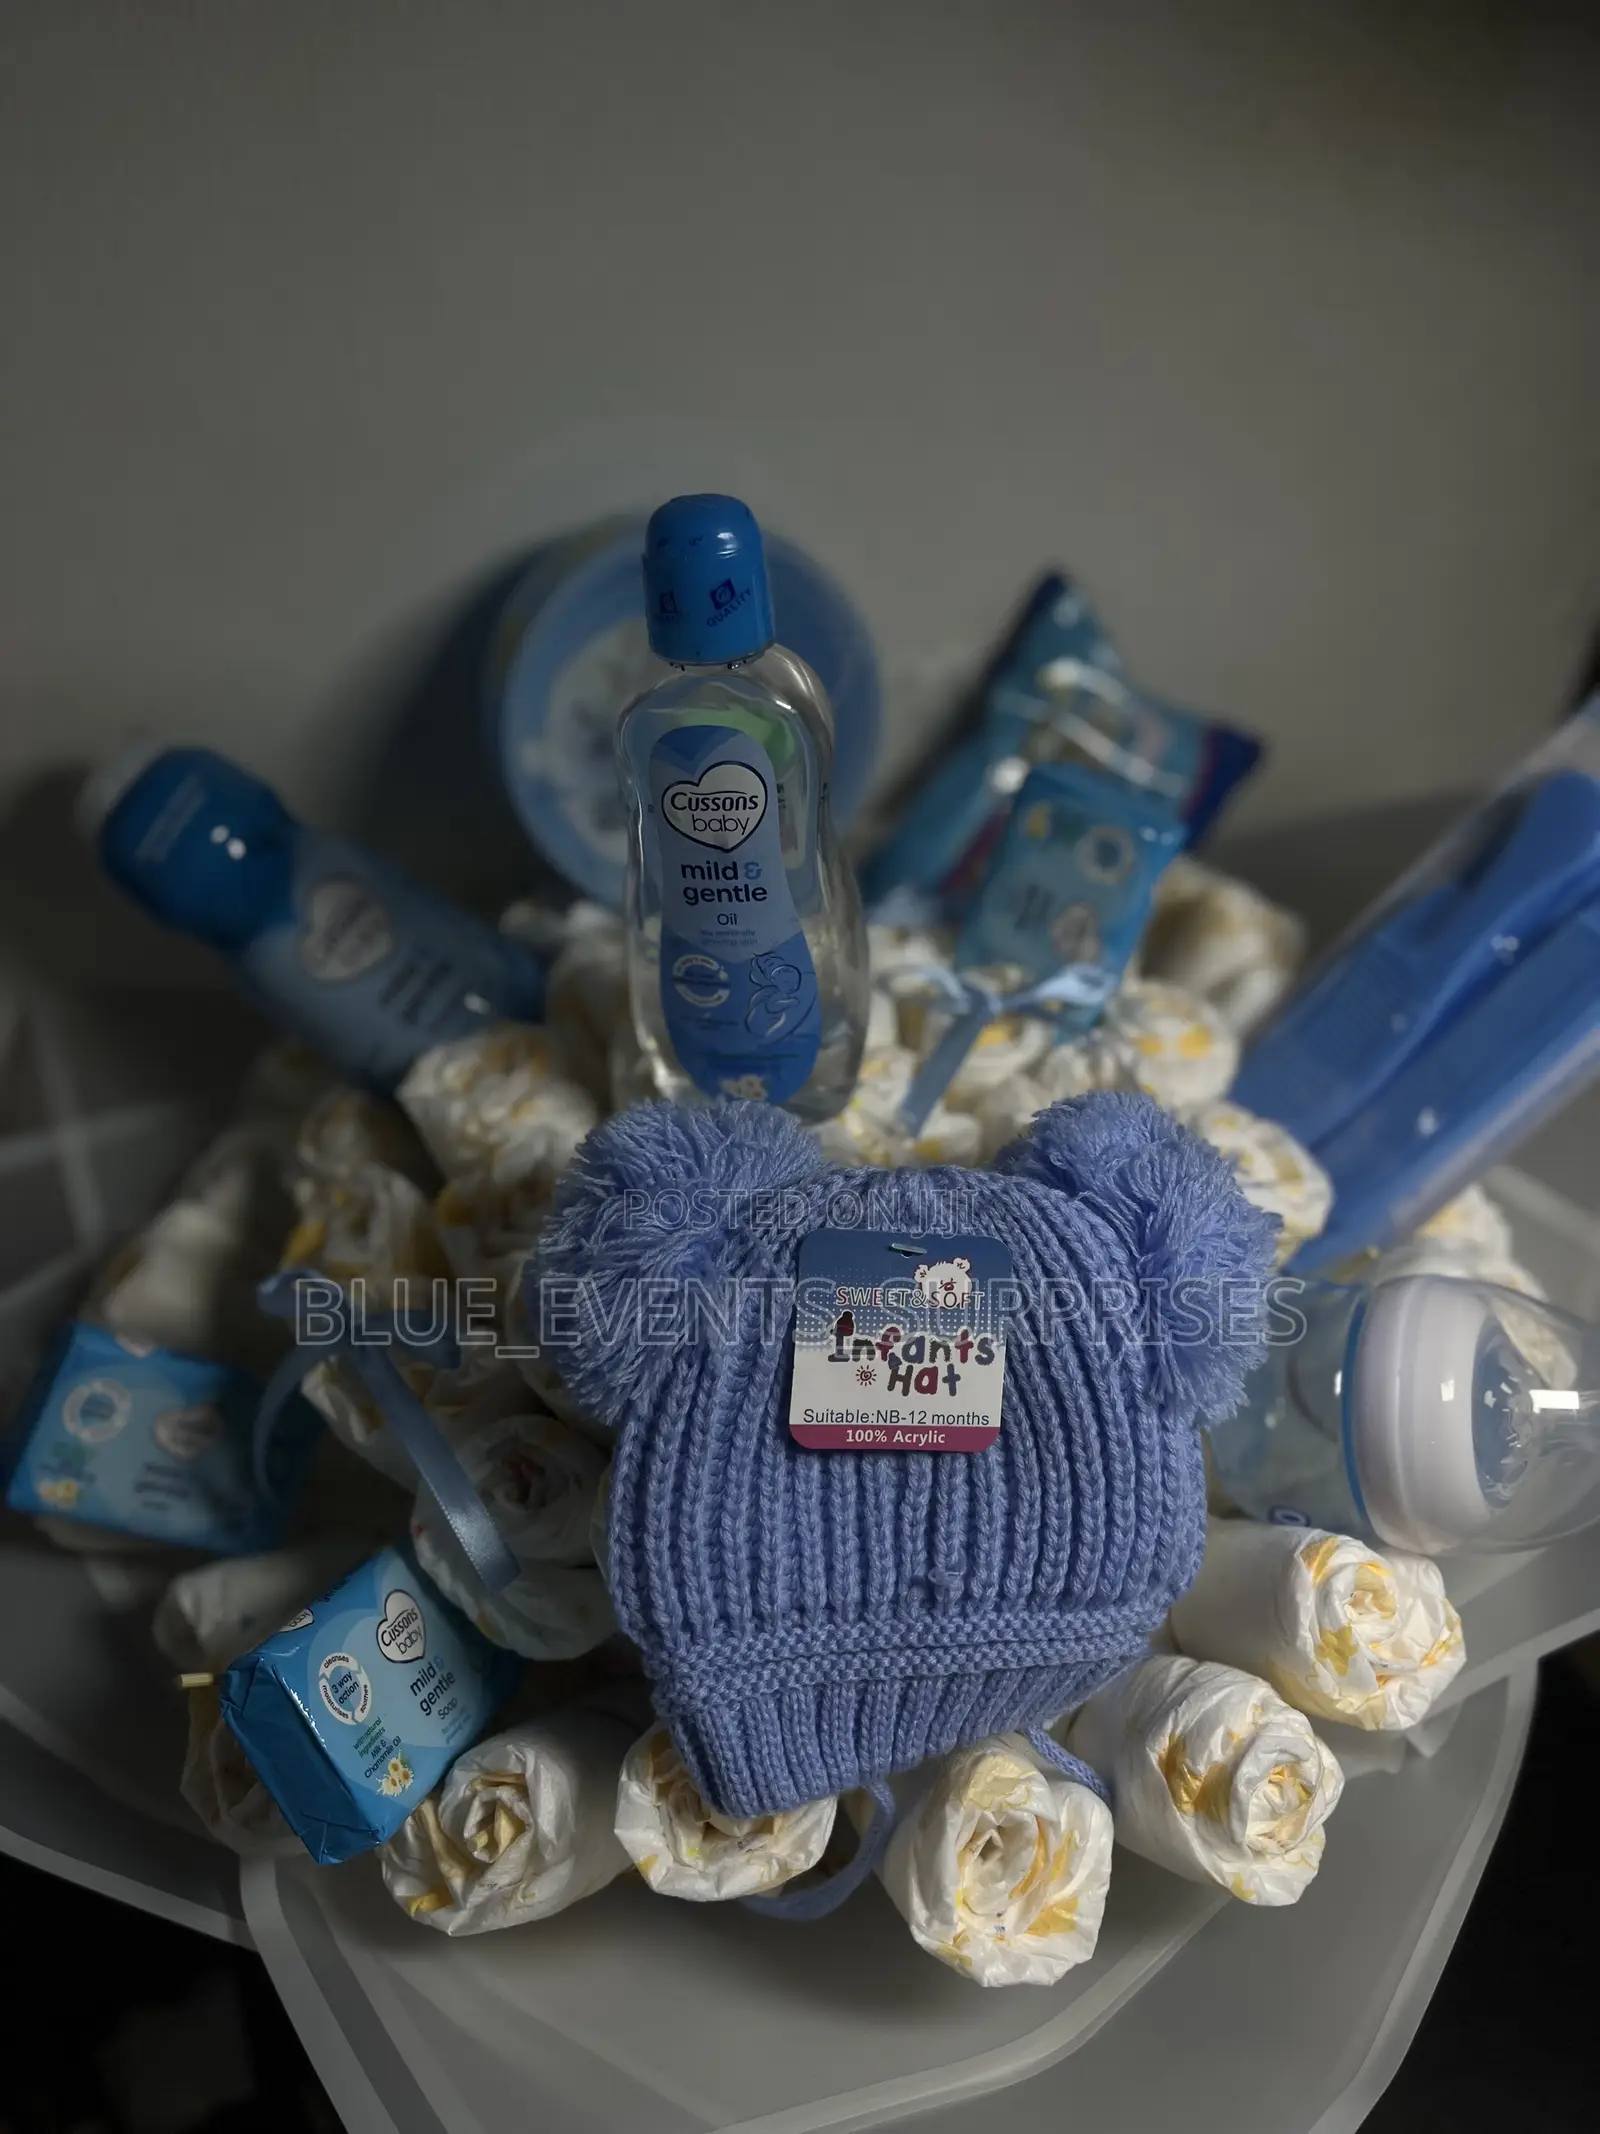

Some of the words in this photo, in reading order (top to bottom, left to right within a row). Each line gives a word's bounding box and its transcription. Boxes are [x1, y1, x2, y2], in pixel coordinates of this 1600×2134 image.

[706, 586, 752, 628] QUALITY
[670, 791, 759, 812] Cussons
[691, 814, 750, 836] baby
[681, 861, 739, 881] mild
[743, 861, 763, 881] &
[682, 884, 768, 906] gentle
[717, 913, 738, 926] Oil
[836, 1286, 985, 1310] SWEET&SOFT
[828, 1313, 996, 1366] Infants
[887, 1359, 961, 1397] Hat
[931, 1411, 990, 1426] months
[845, 1429, 887, 1443] 100%
[892, 1430, 946, 1446] Acrylic
[381, 1608, 419, 1647] Cussons
[395, 1626, 423, 1655] baby
[323, 1655, 350, 1669] cleanses
[331, 1683, 339, 1694] 3
[338, 1671, 353, 1688] way
[410, 1662, 437, 1696] mild
[338, 1681, 360, 1705] action
[360, 1684, 369, 1713] soothes
[420, 1671, 456, 1716] gentle
